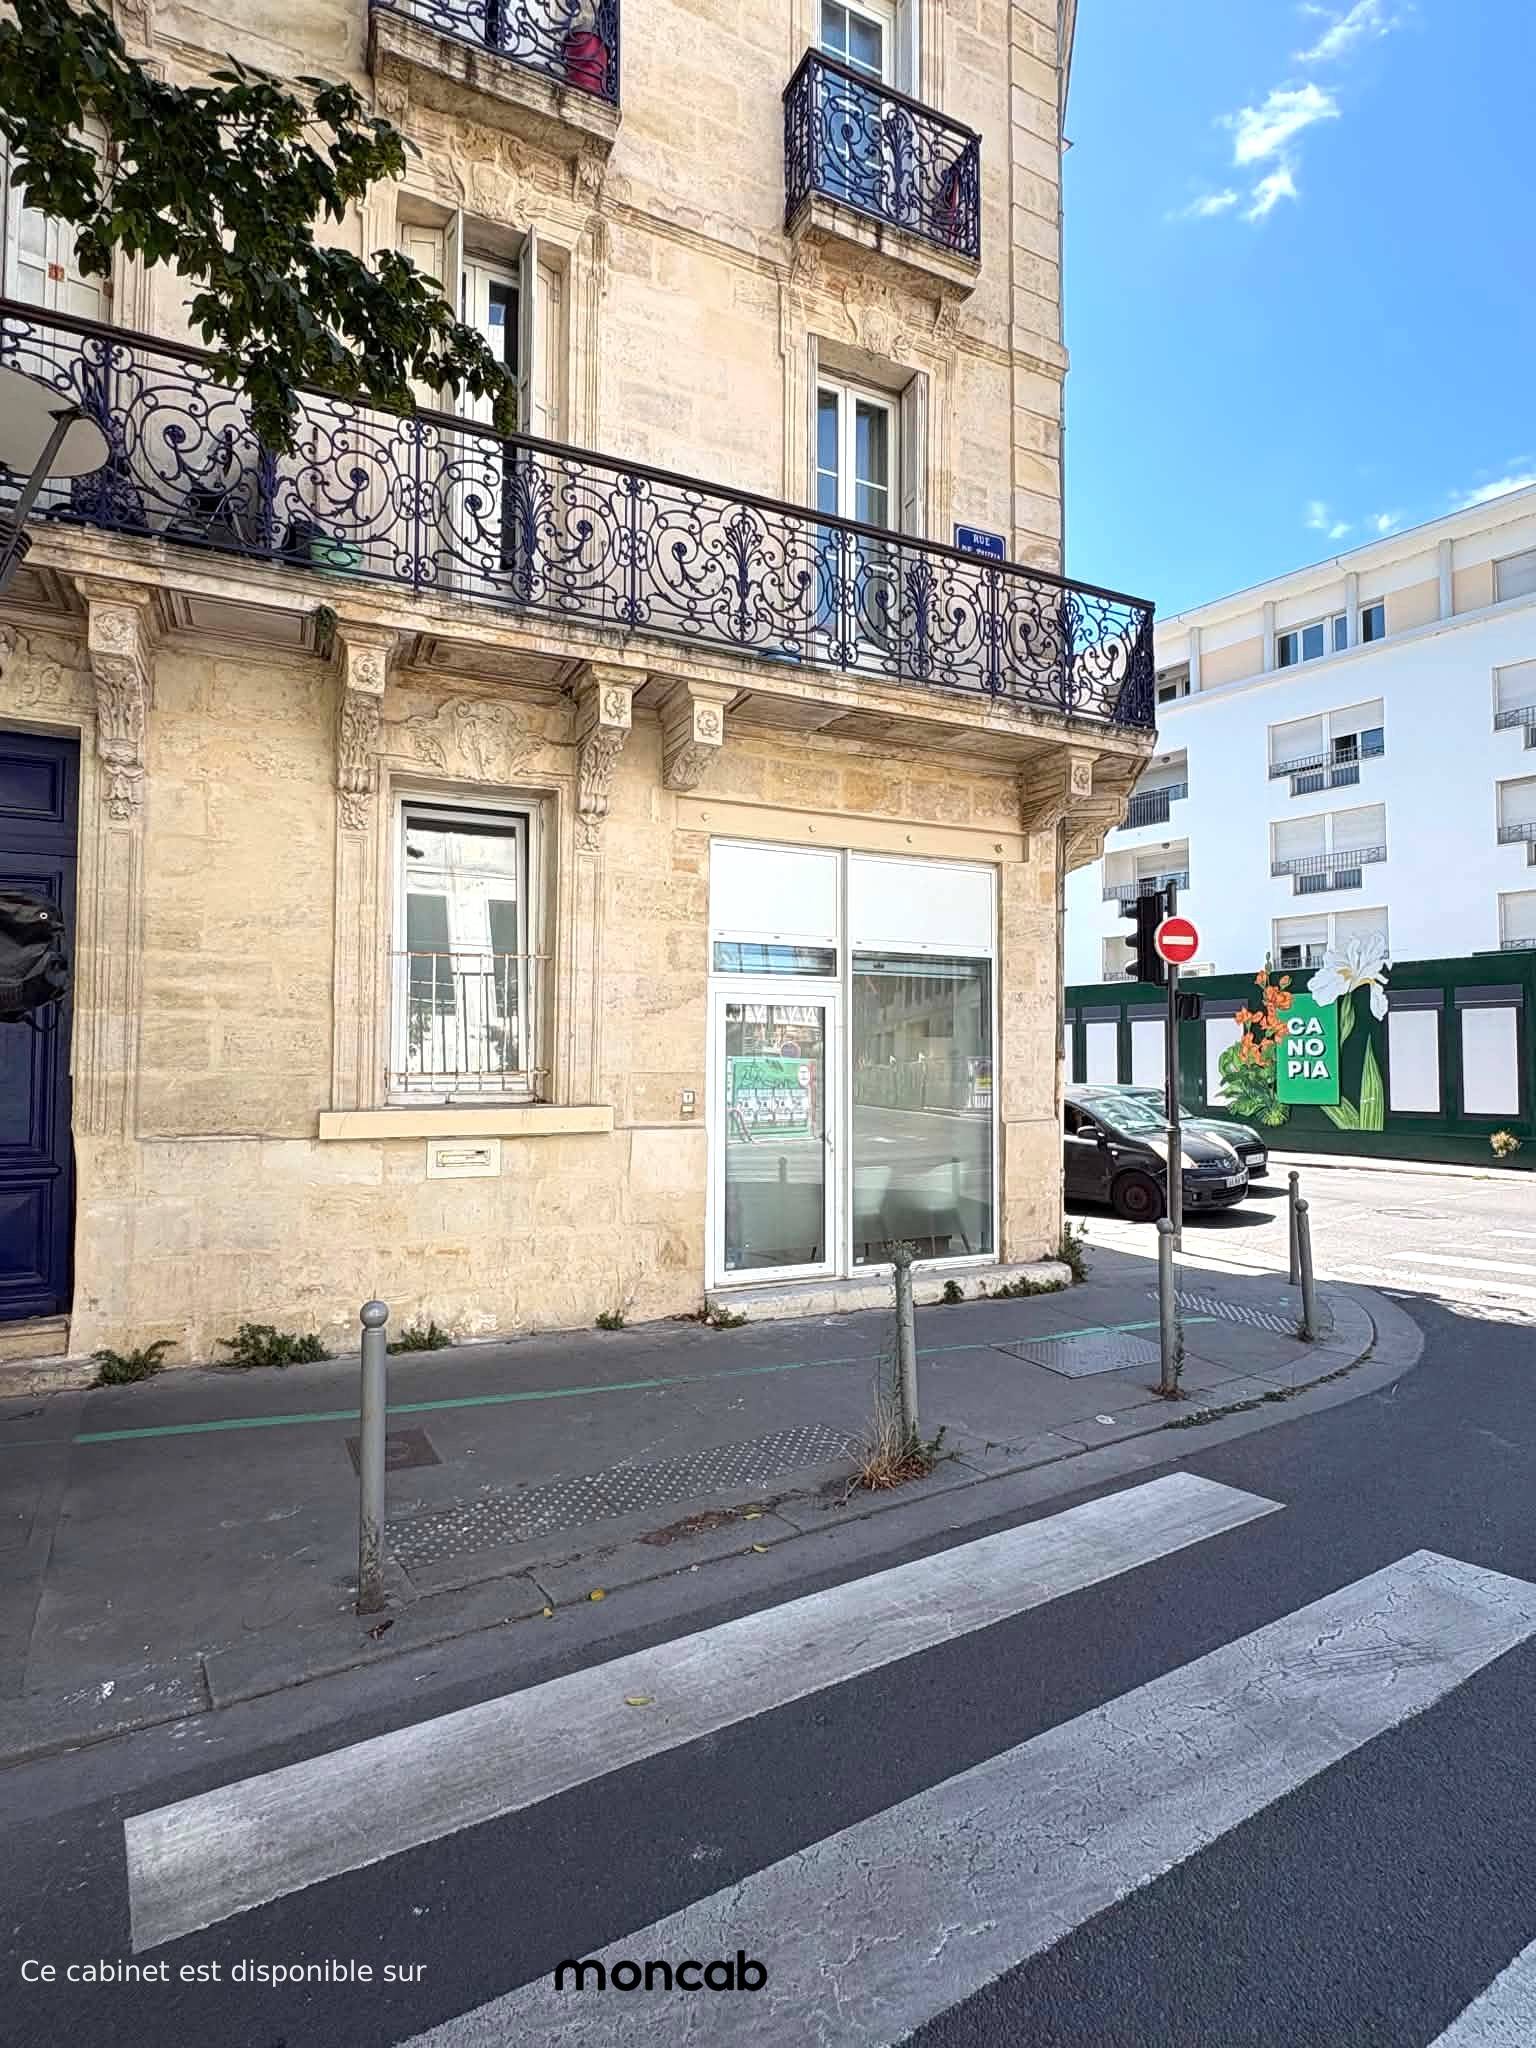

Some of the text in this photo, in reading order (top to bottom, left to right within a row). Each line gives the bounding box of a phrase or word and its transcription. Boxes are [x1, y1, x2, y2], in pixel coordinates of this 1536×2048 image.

[973, 534, 991, 547] RUE
[1287, 1017, 1323, 1035] CA
[1287, 1039, 1325, 1057] NO
[1288, 1060, 1329, 1079] PIA
